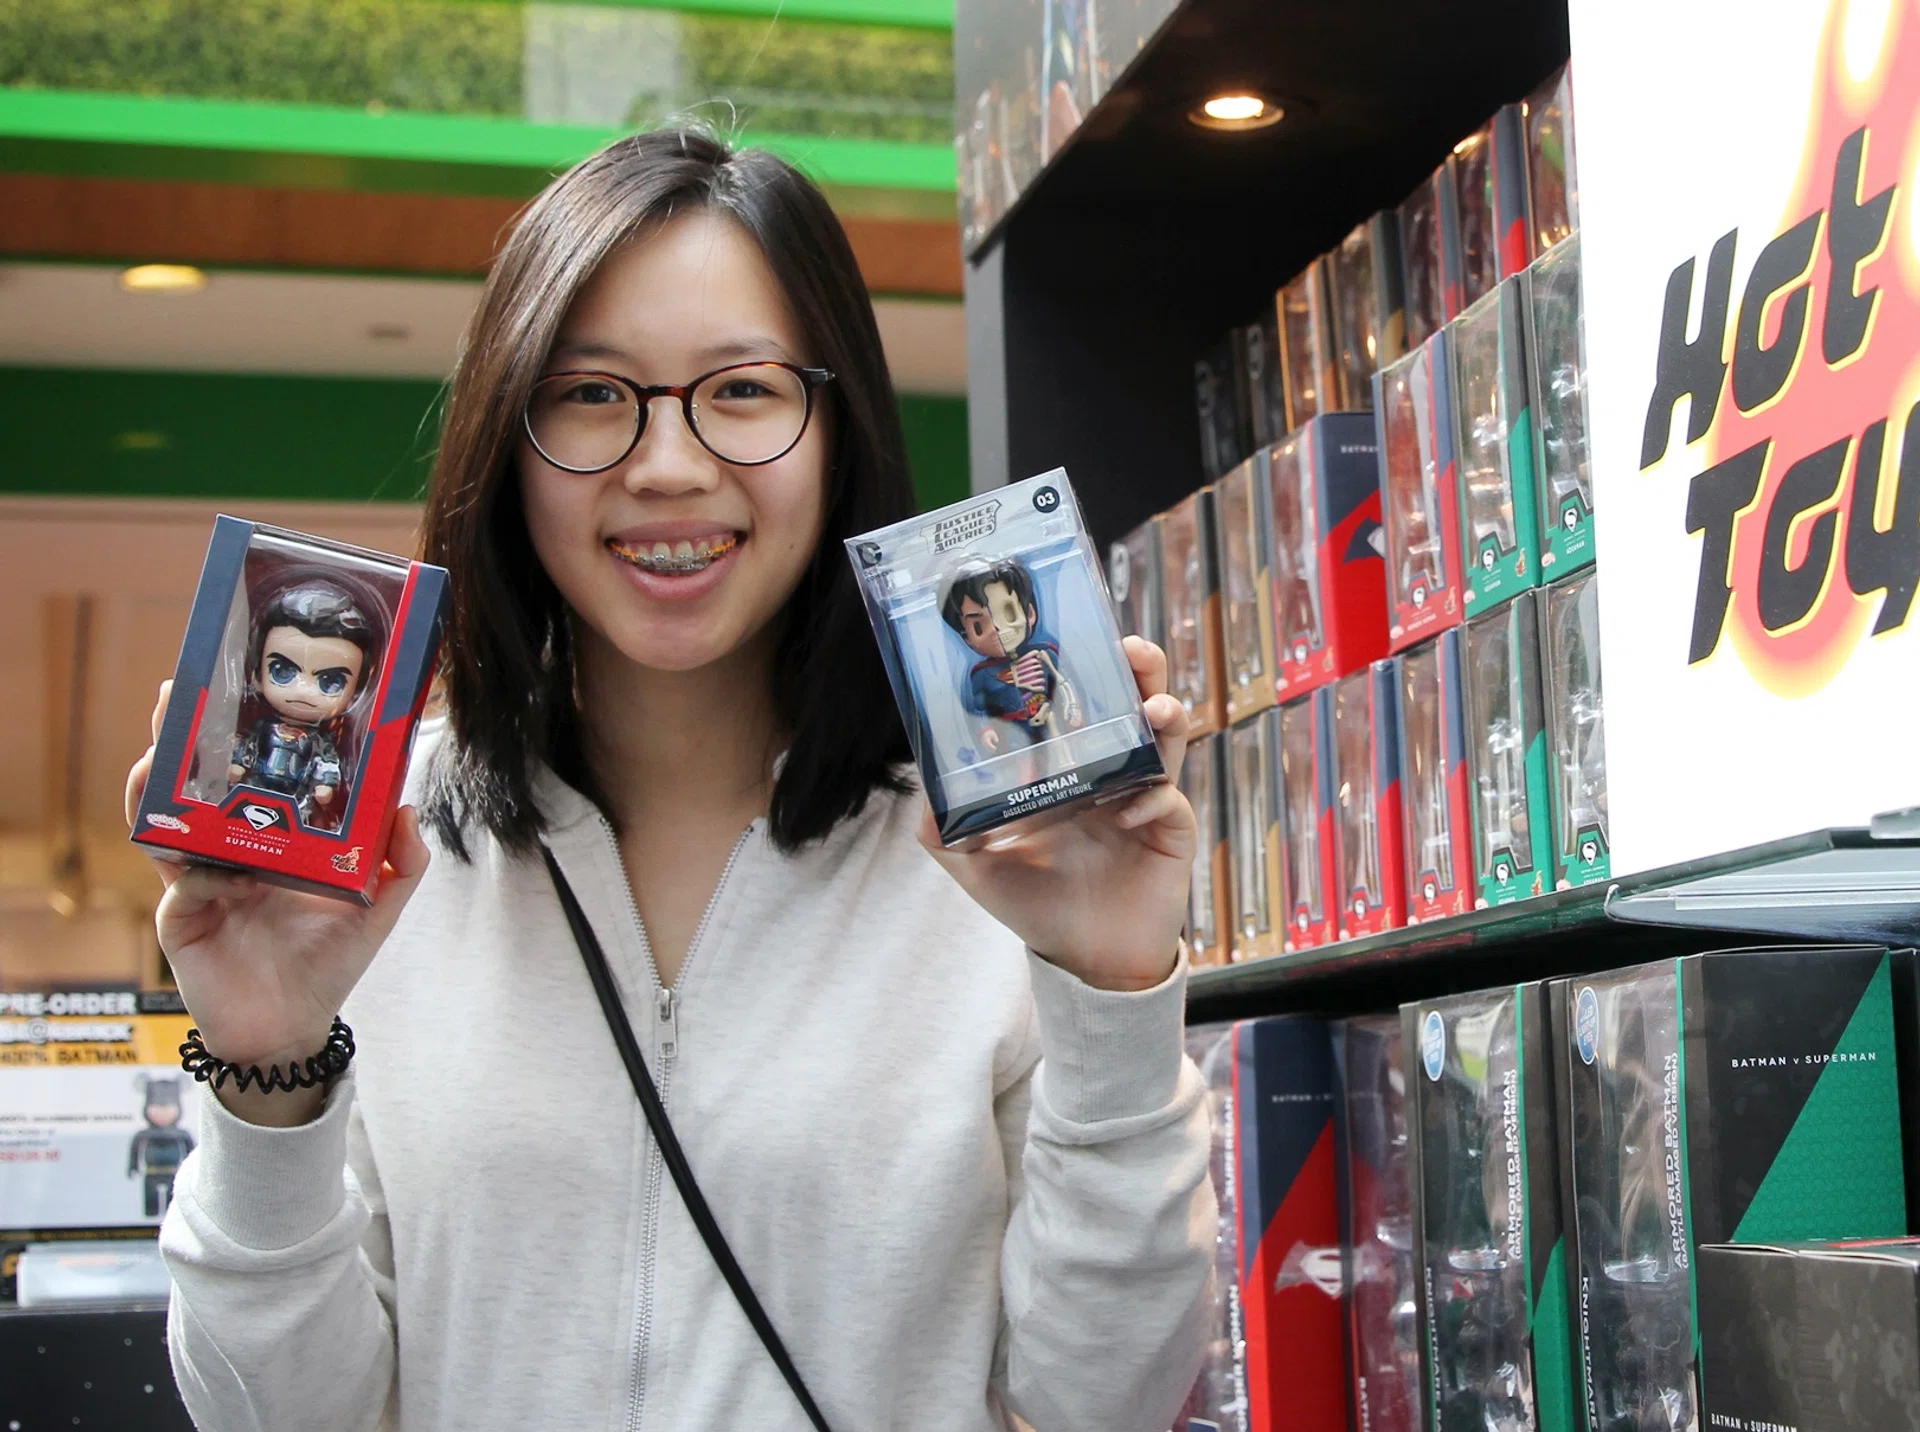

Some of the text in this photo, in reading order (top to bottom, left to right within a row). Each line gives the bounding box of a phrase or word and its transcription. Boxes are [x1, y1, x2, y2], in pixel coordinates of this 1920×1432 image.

[1639, 125, 1899, 472] Hot
[1036, 491, 1056, 507] 03
[933, 505, 994, 534] JUSTICE
[935, 516, 987, 544] LEAGUE
[934, 523, 993, 555] AMERICA
[1002, 781, 1093, 819] DISSECTED VINYL ART FIGURE
[1007, 772, 1079, 806] SUPERMAN
[225, 836, 283, 856] SUPERMAN
[1732, 1056, 1787, 1068] BATMAN
[1805, 1052, 1876, 1064] SUPERMAN
[1503, 1070, 1517, 1260] ARMORED BATMAN
[1664, 1055, 1682, 1269] ARMORED BATMAN
[1671, 1052, 1689, 1270] (BATTLE DAMAGED VERSION)
[1582, 1276, 1599, 1430] KNIGHTMARE
[1233, 1363, 1248, 1432] ONDER
[1711, 1413, 1742, 1430] BATMAN
[1744, 1422, 1749, 1431] v
